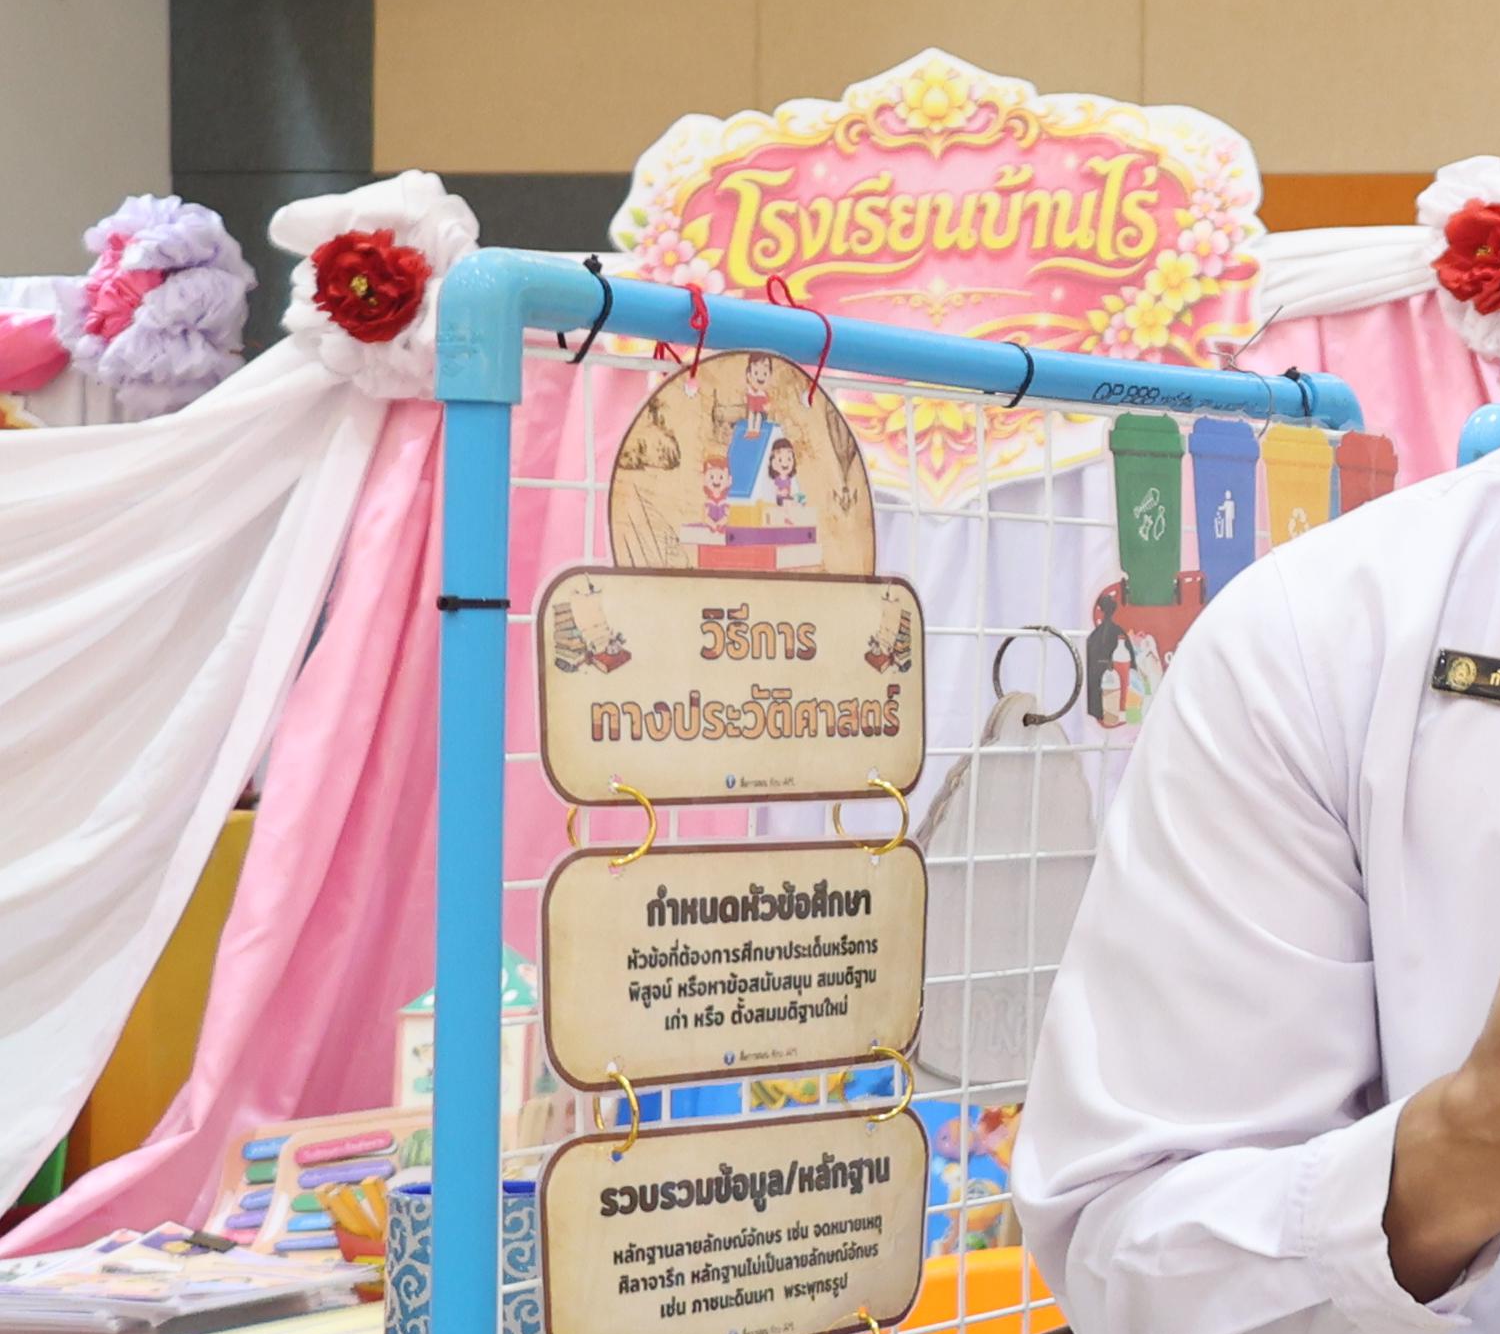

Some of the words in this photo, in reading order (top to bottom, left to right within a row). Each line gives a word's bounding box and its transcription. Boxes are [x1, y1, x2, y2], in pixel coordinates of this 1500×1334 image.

[716, 154, 1159, 282] โรงเรียนบ้านไร่
[699, 603, 818, 661] วิธีการ
[591, 683, 901, 742] ทางประวัติศาสตร์
[646, 879, 872, 928] กำหนดหัวข้อศึกษา
[627, 936, 879, 971] หัวข้อที่ต้องการศึกษาประเด็นหรือการ
[628, 976, 673, 1010] พิสูจน์
[677, 972, 813, 1001] หรือหาข้อสนับสนุน
[665, 1006, 688, 1031] เก่า
[693, 1000, 725, 1028] หรือ
[600, 1152, 891, 1217] รวบรวมข้อมูล/หลักฐาน
[613, 1229, 783, 1267] หลักฐานลายลักษณ์อักษร
[786, 1222, 809, 1244] เช่น
[813, 1213, 883, 1241] จดหมายเหตุ
[618, 1265, 687, 1295] ศิลาจารึก
[660, 1296, 687, 1320] เช่น
[692, 1287, 776, 1317] ภาชนะดินเผา
[783, 1273, 850, 1305] พระพุทธรูป
